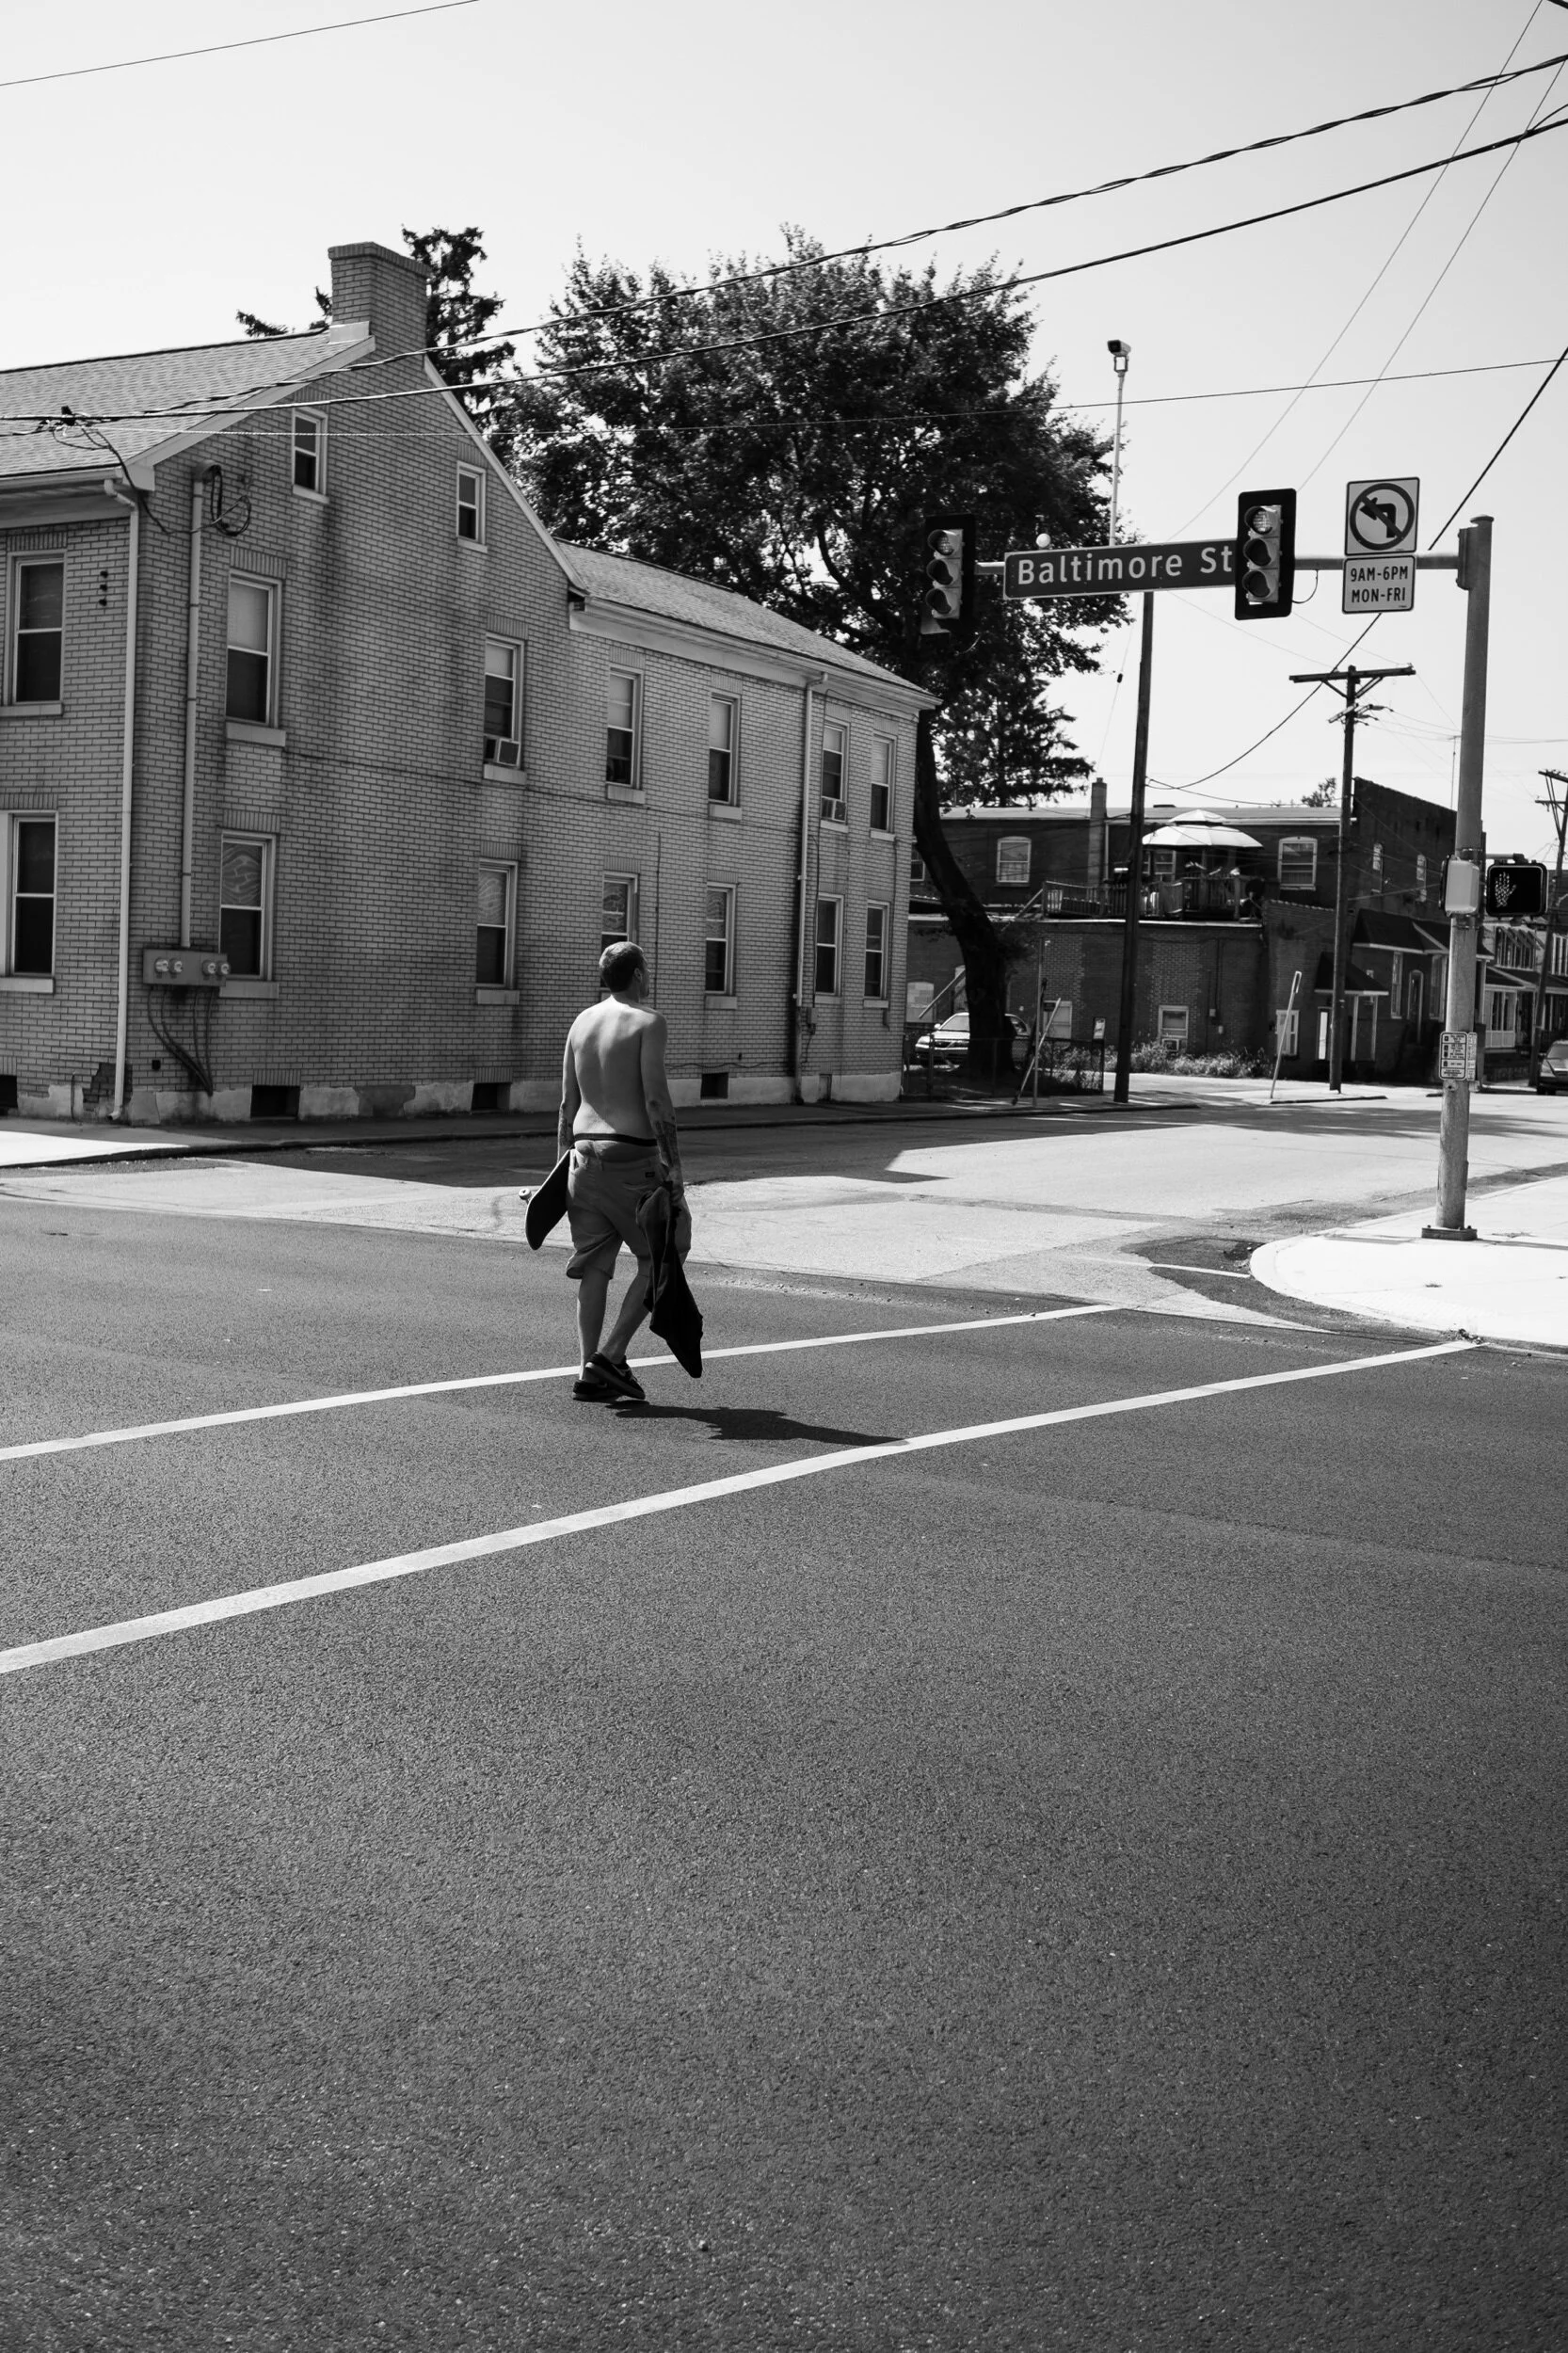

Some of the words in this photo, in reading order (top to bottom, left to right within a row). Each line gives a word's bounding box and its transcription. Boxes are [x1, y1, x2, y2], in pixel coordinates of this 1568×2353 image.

[1017, 552, 1182, 584] Baltimore
[1200, 545, 1233, 574] St
[1351, 566, 1408, 582] 9AM-6PM
[1352, 587, 1405, 602] MON-FRI
